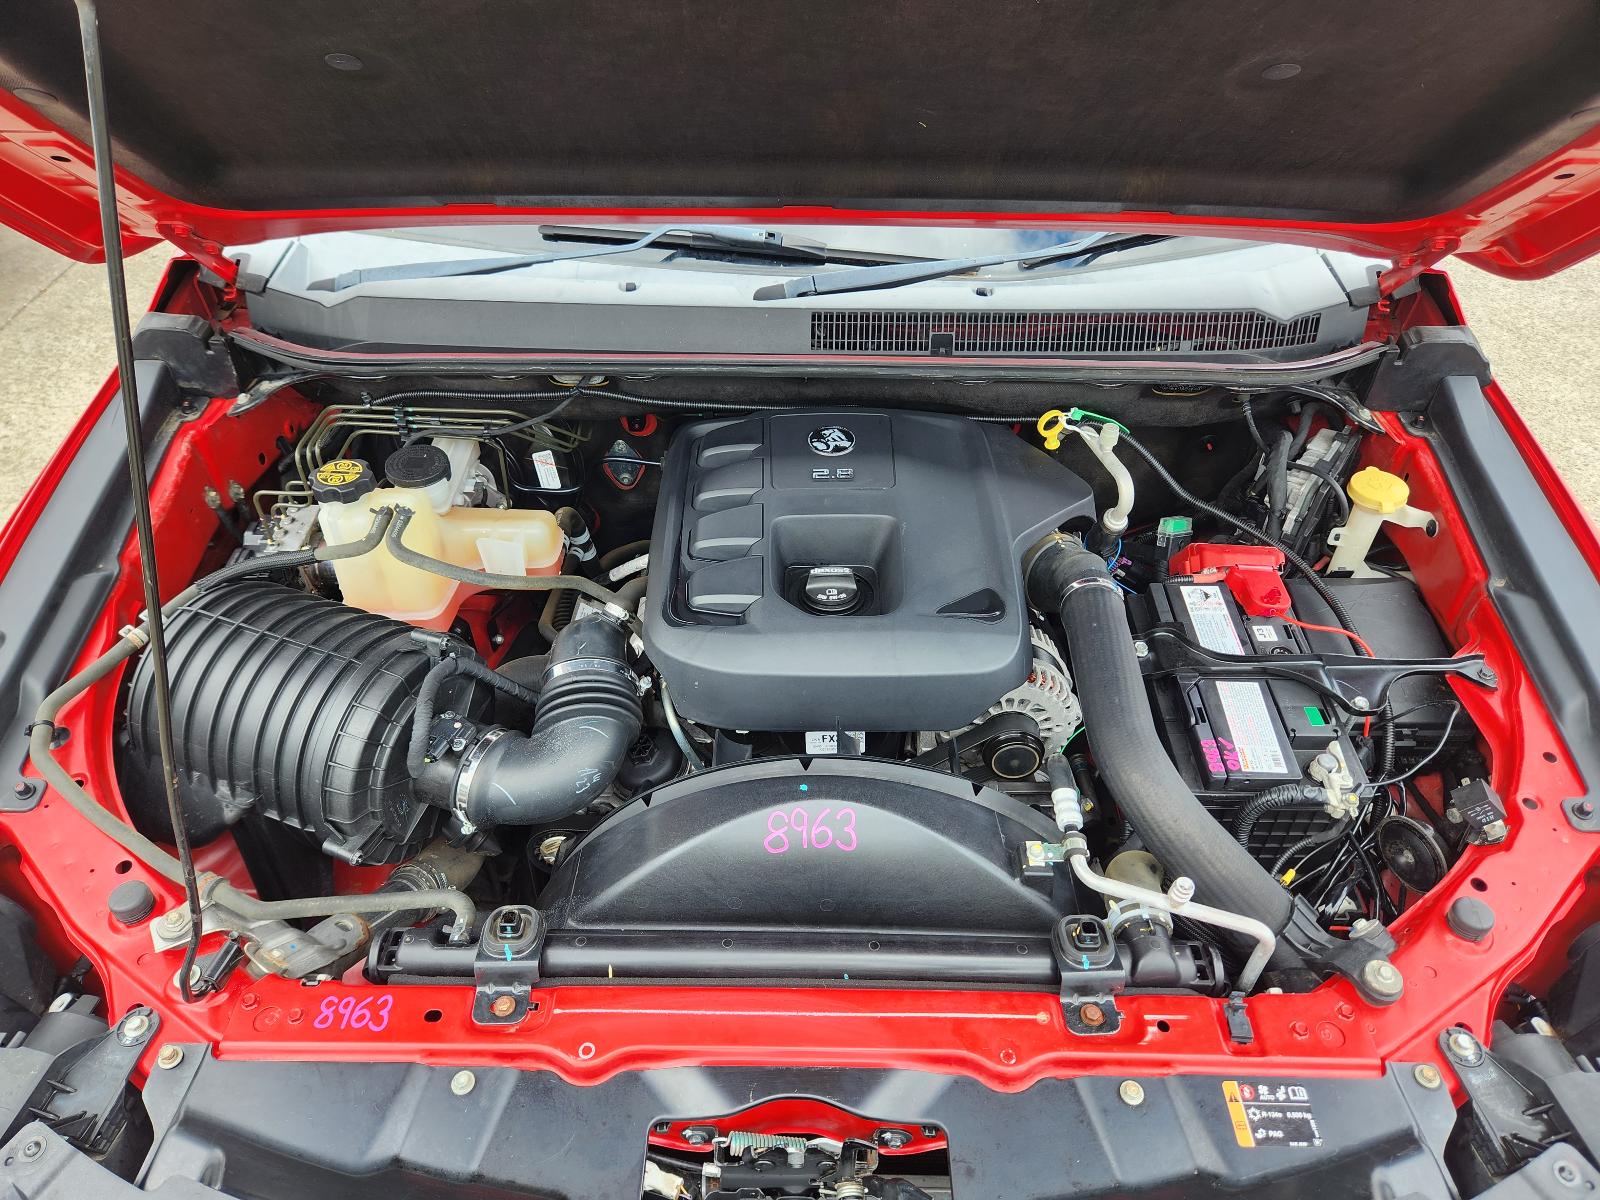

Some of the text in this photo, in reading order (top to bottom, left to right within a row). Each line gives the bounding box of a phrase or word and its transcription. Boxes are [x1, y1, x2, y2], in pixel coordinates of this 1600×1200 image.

[812, 468, 854, 479] 2.8
[821, 734, 838, 743] FX
[763, 807, 857, 853] 8963
[313, 994, 394, 1032] 8963
